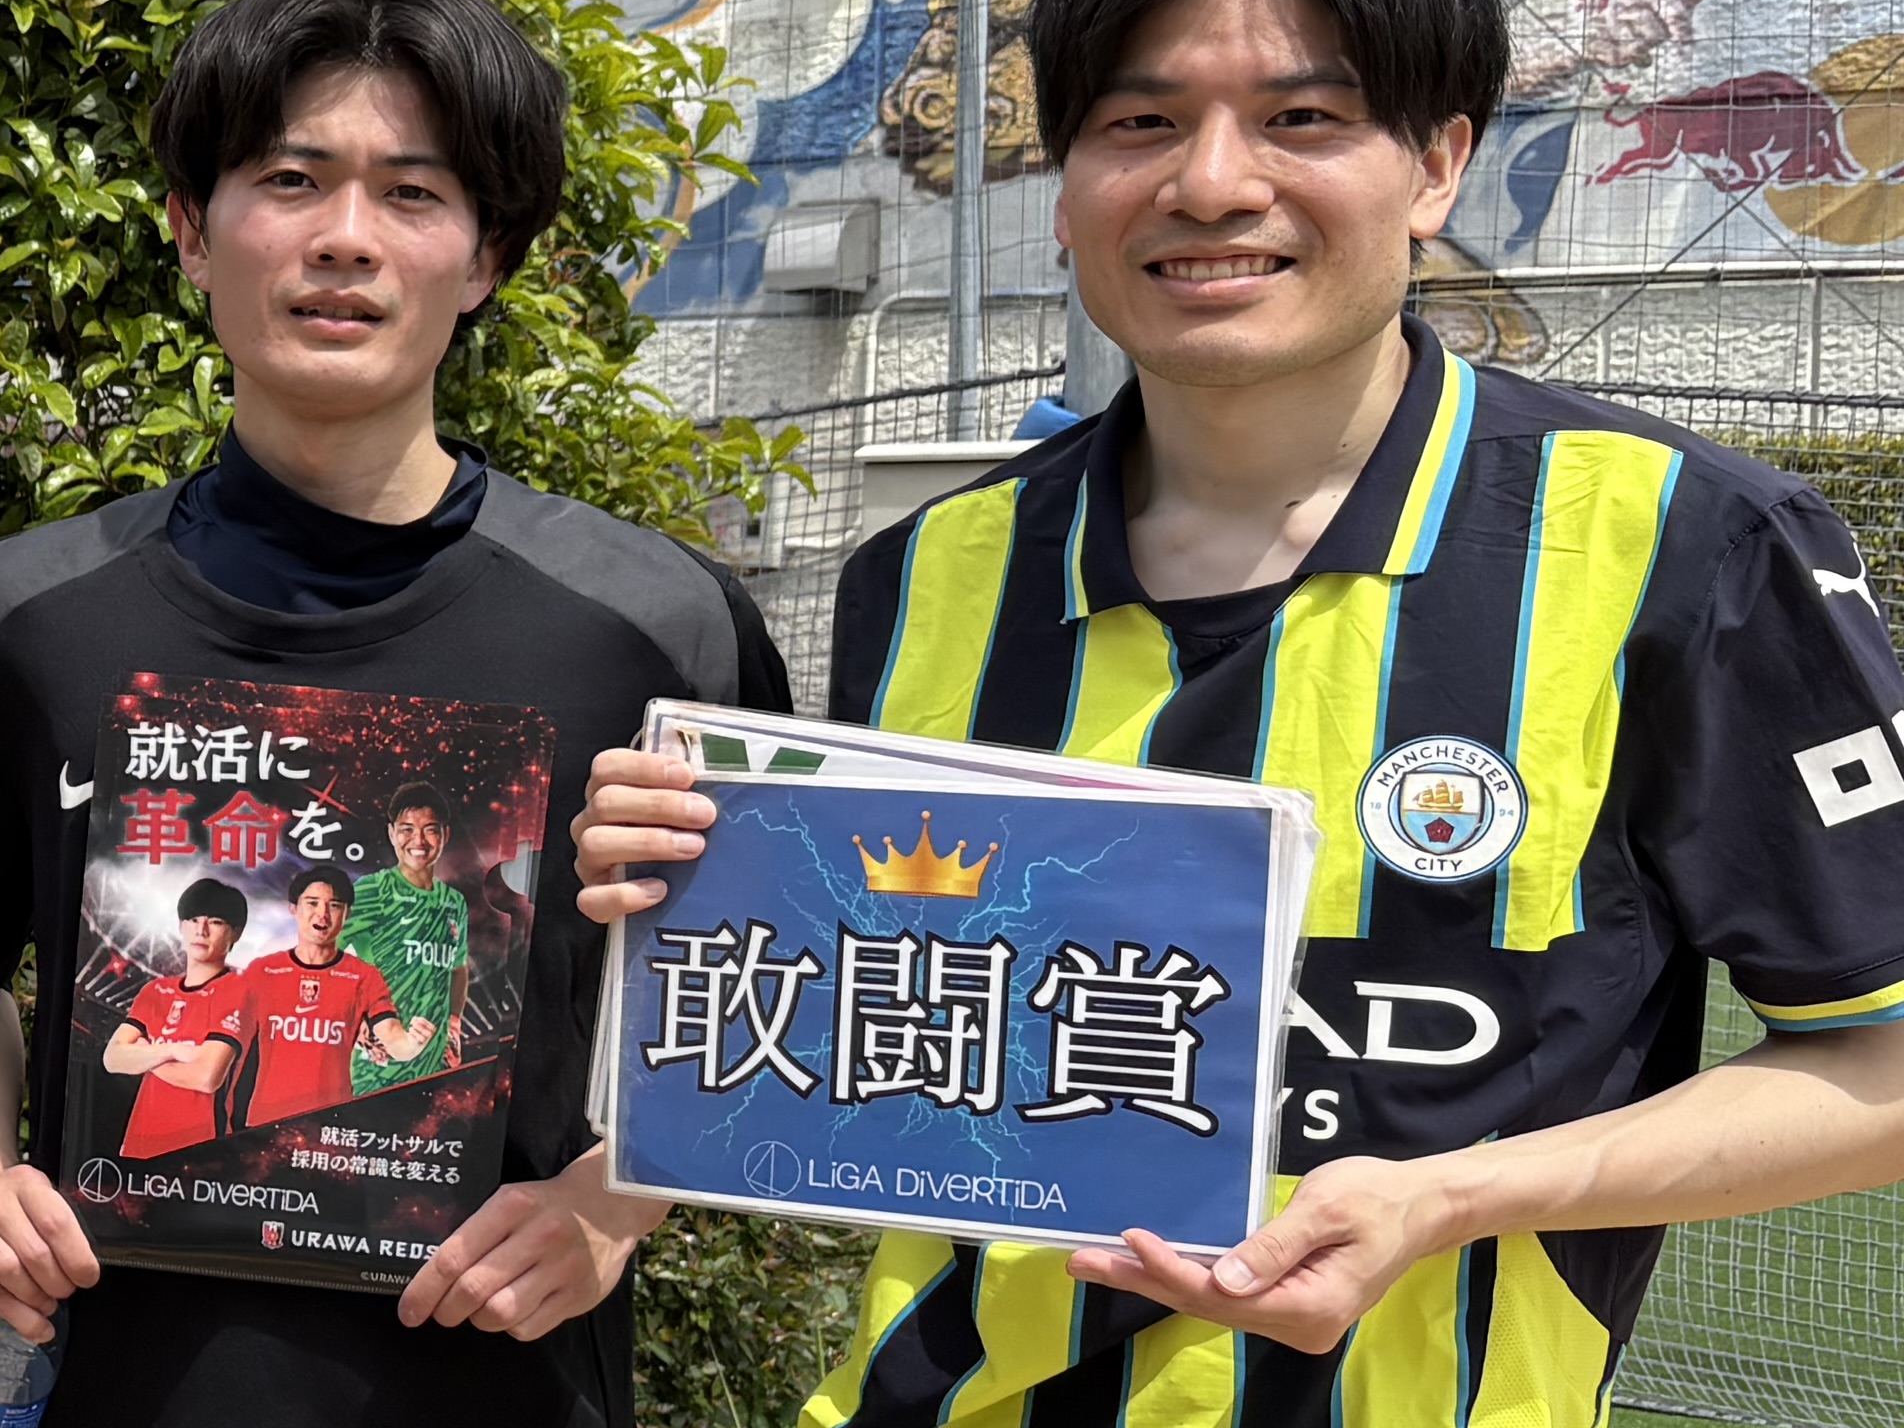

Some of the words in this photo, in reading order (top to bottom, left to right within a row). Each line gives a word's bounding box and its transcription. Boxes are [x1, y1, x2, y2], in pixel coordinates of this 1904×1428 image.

[124, 721, 312, 783] 就活に
[1376, 744, 1510, 794] MANCHESTER
[115, 787, 367, 871] 革命を。
[1414, 857, 1464, 872] CITY
[268, 1015, 347, 1045] POLUS
[644, 920, 1228, 1136] 敢闘賞
[319, 1125, 464, 1159] 就活フットサルで
[290, 1148, 462, 1186] 採用の常識を変える
[291, 1229, 371, 1255] URAWA
[379, 1239, 441, 1261] REDS
